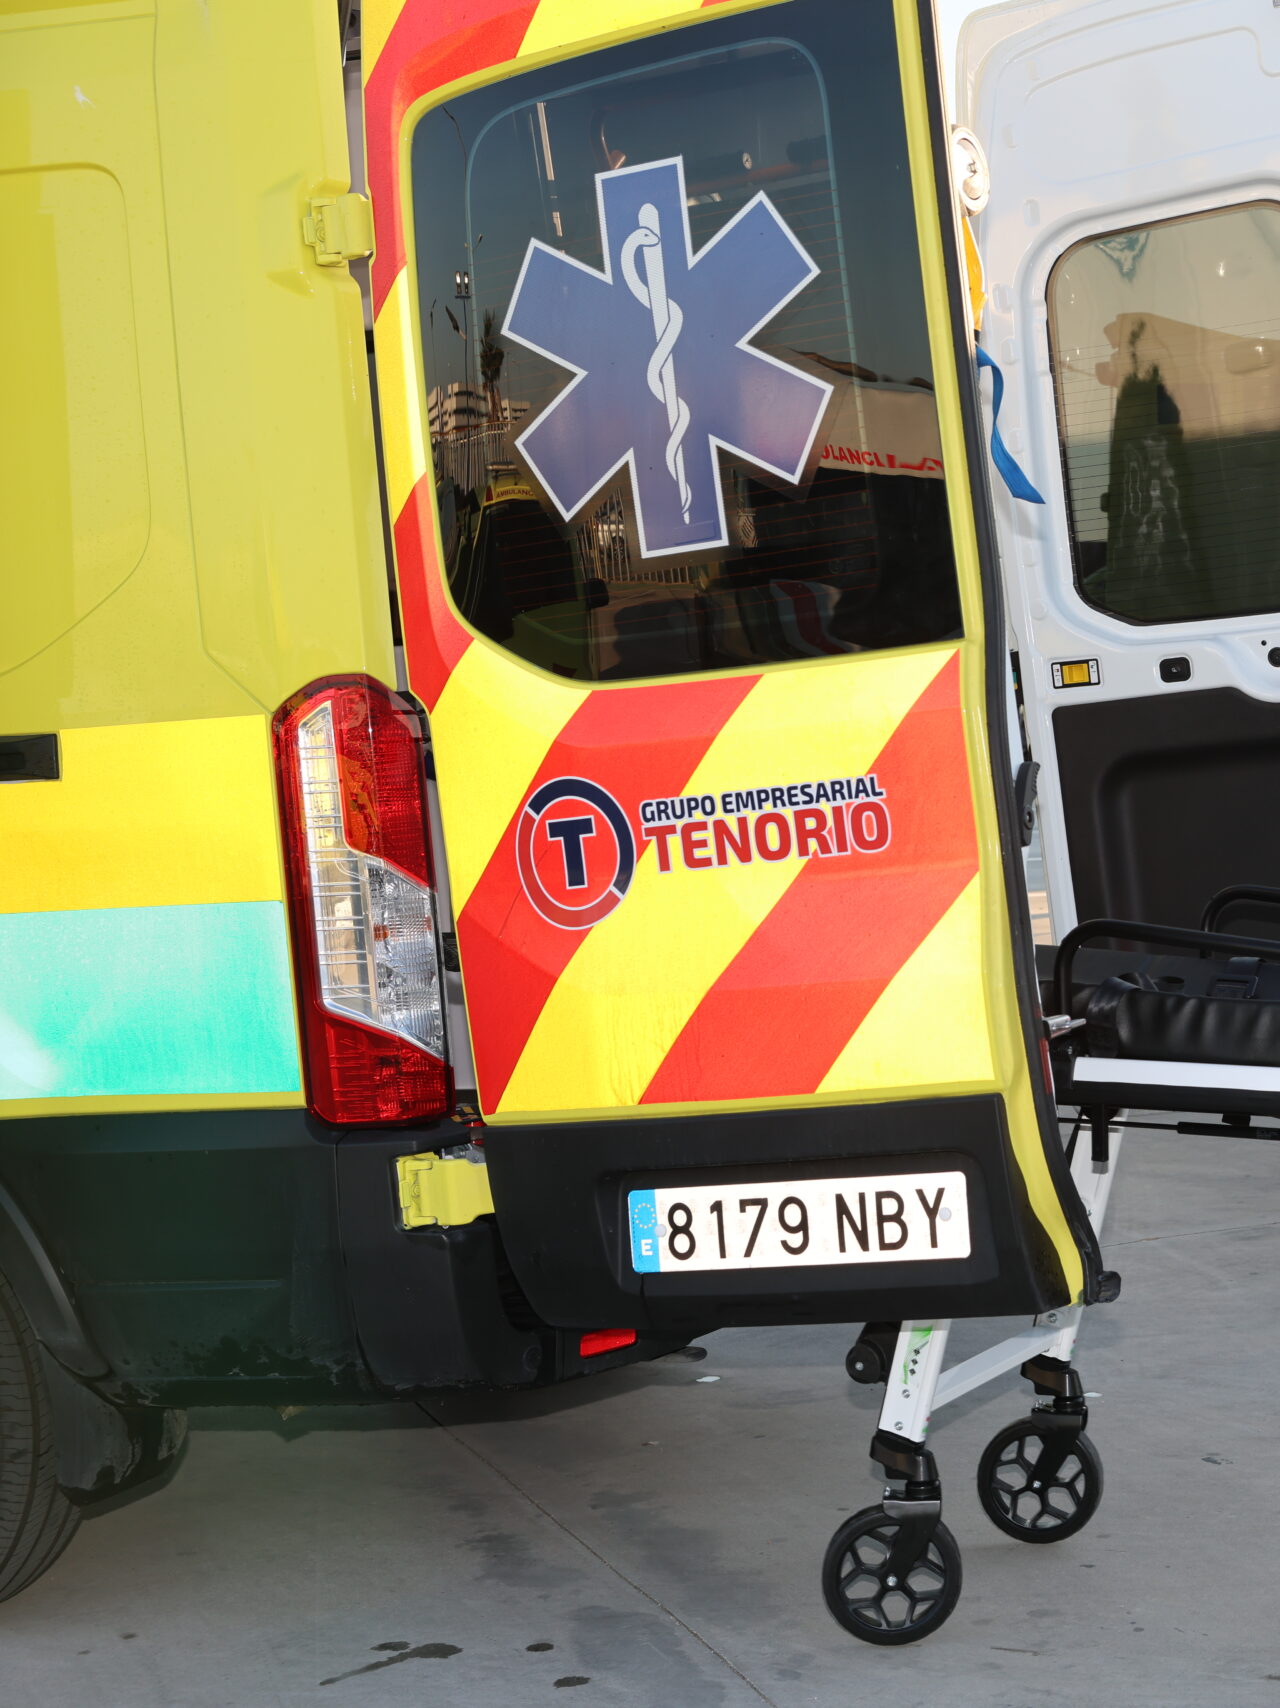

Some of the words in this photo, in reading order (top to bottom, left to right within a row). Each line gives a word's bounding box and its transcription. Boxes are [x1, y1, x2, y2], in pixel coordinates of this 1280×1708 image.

[641, 795, 716, 823] GRUPO
[721, 776, 884, 814] EMPRESARIAL
[548, 816, 594, 888] T
[643, 801, 890, 873] TENORIO
[641, 1239, 654, 1257] E
[667, 1196, 810, 1261] 8179
[834, 1187, 946, 1254] NBY
